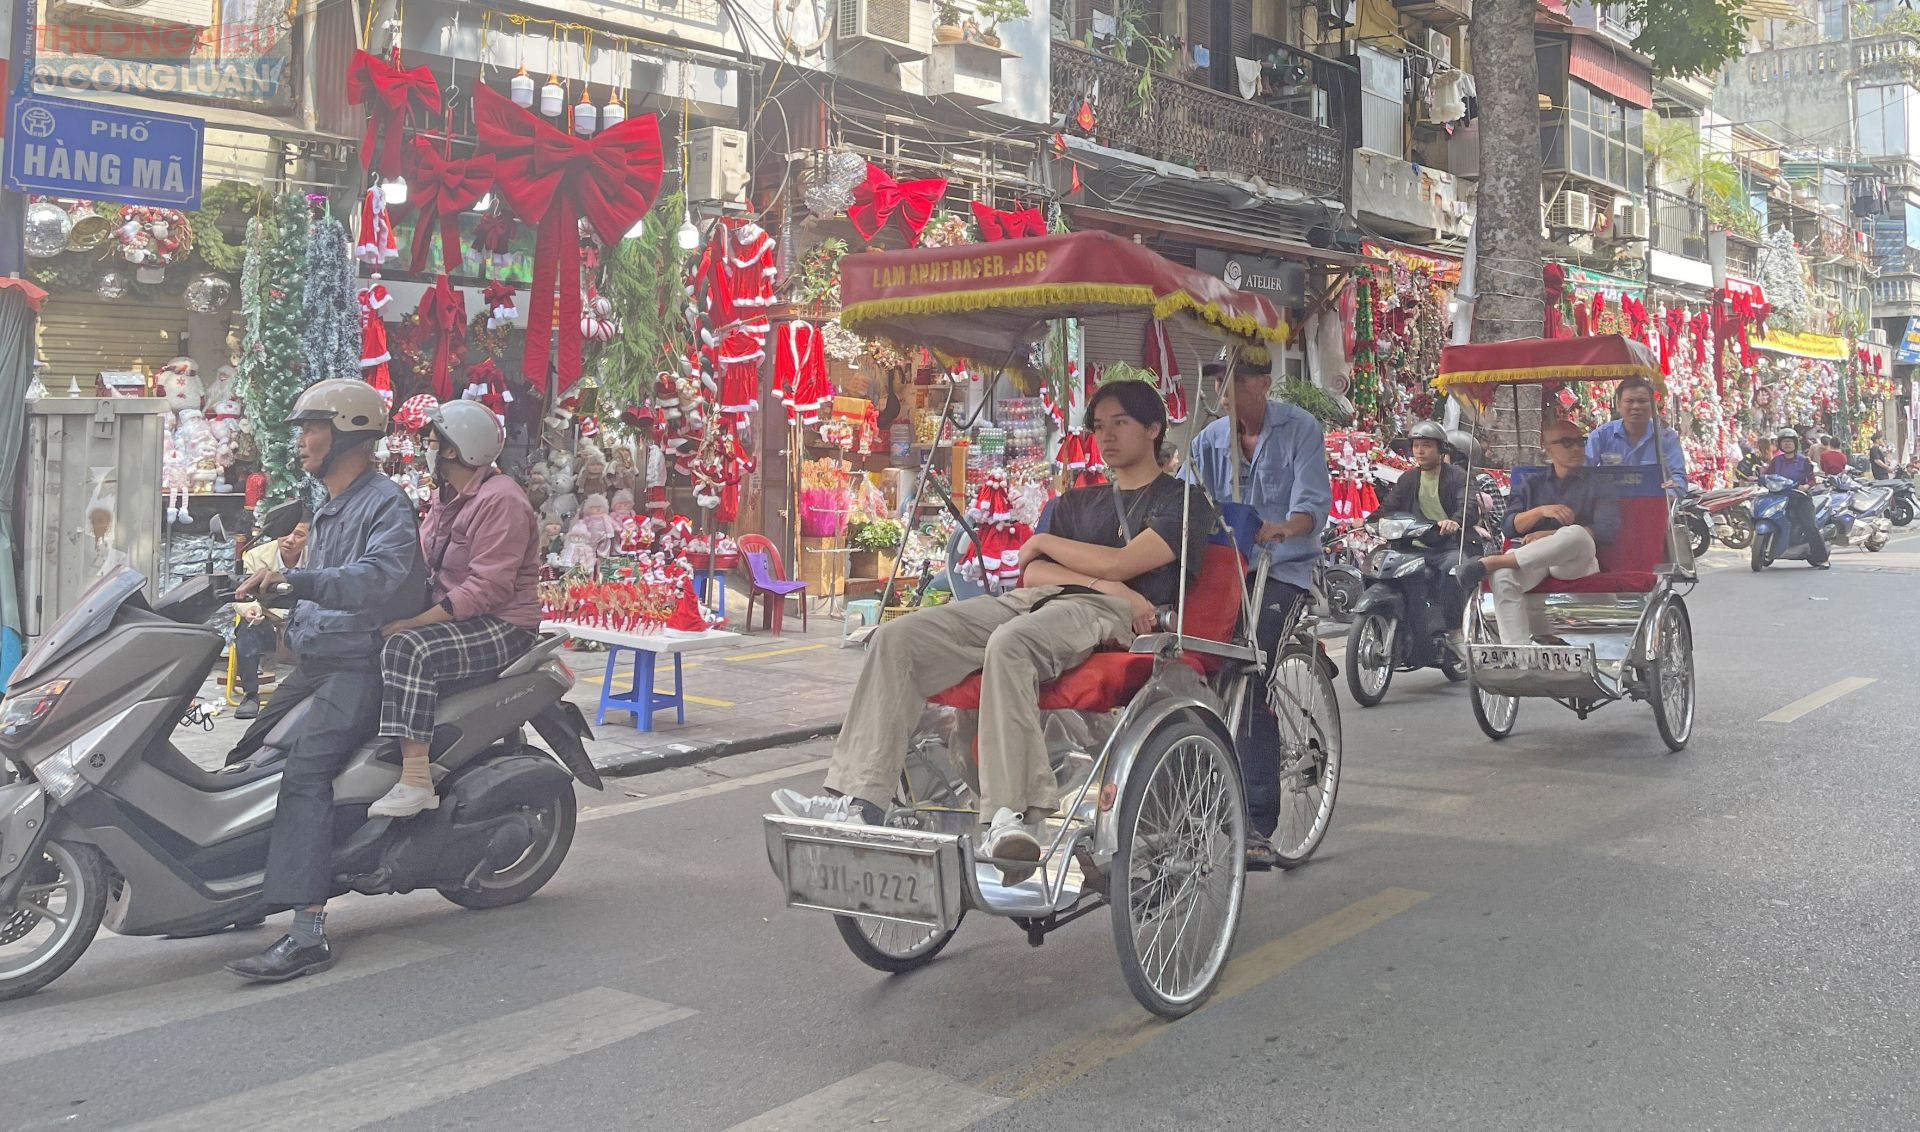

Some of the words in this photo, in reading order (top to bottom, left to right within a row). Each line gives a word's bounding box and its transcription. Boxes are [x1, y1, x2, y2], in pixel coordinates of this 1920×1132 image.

[91, 120, 152, 142] PHỐ
[23, 138, 121, 186] HÀNG
[132, 154, 184, 193] MÃ
[872, 265, 906, 288] LAM
[1245, 274, 1282, 291] ATELIER
